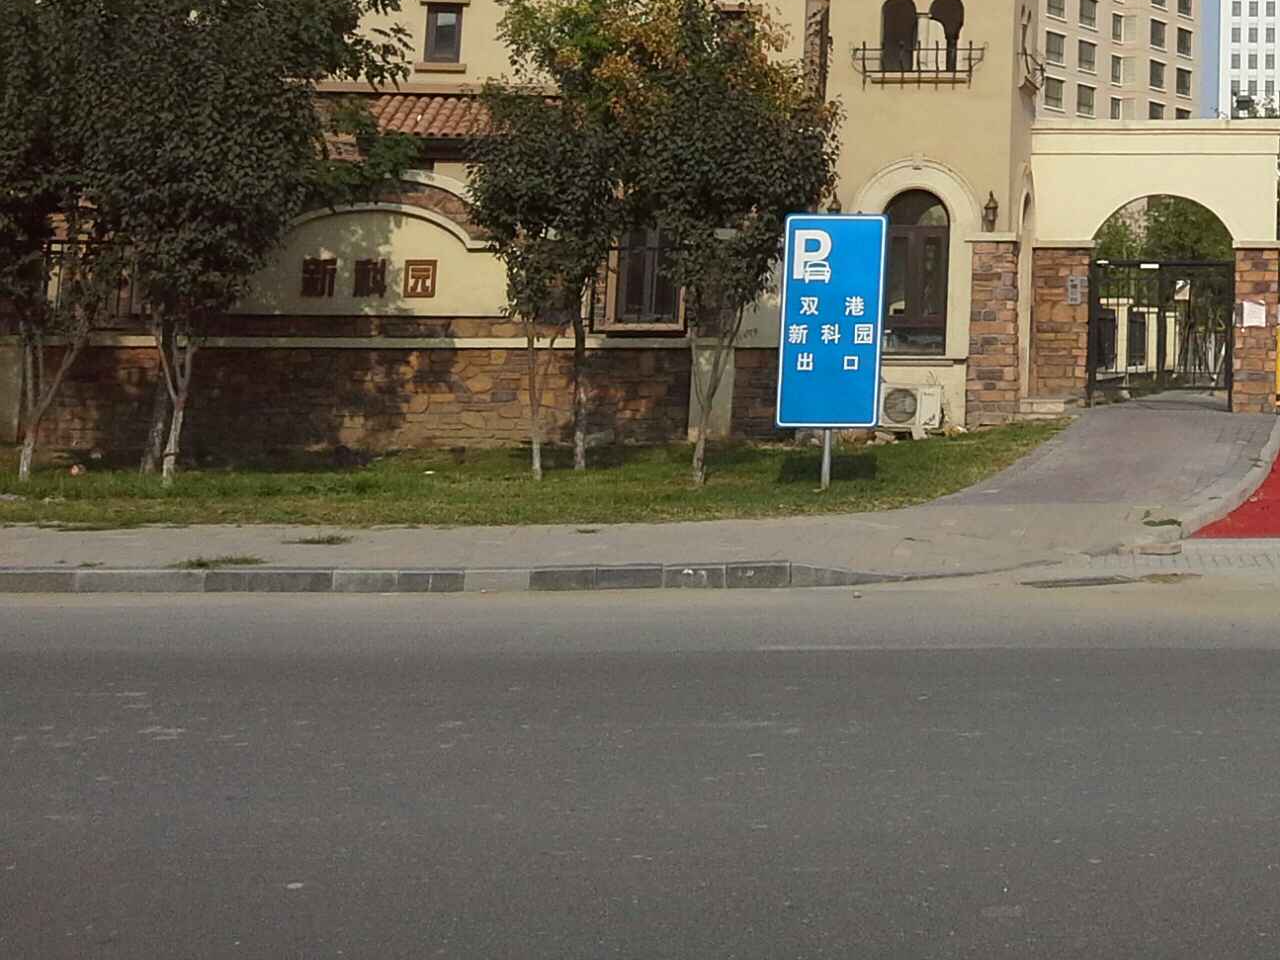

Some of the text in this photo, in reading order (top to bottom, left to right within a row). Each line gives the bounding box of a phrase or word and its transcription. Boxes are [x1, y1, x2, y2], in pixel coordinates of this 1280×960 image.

[792, 228, 832, 280] P
[799, 296, 865, 316] 双港
[788, 323, 874, 345] 新科园
[796, 353, 859, 371] 出口
